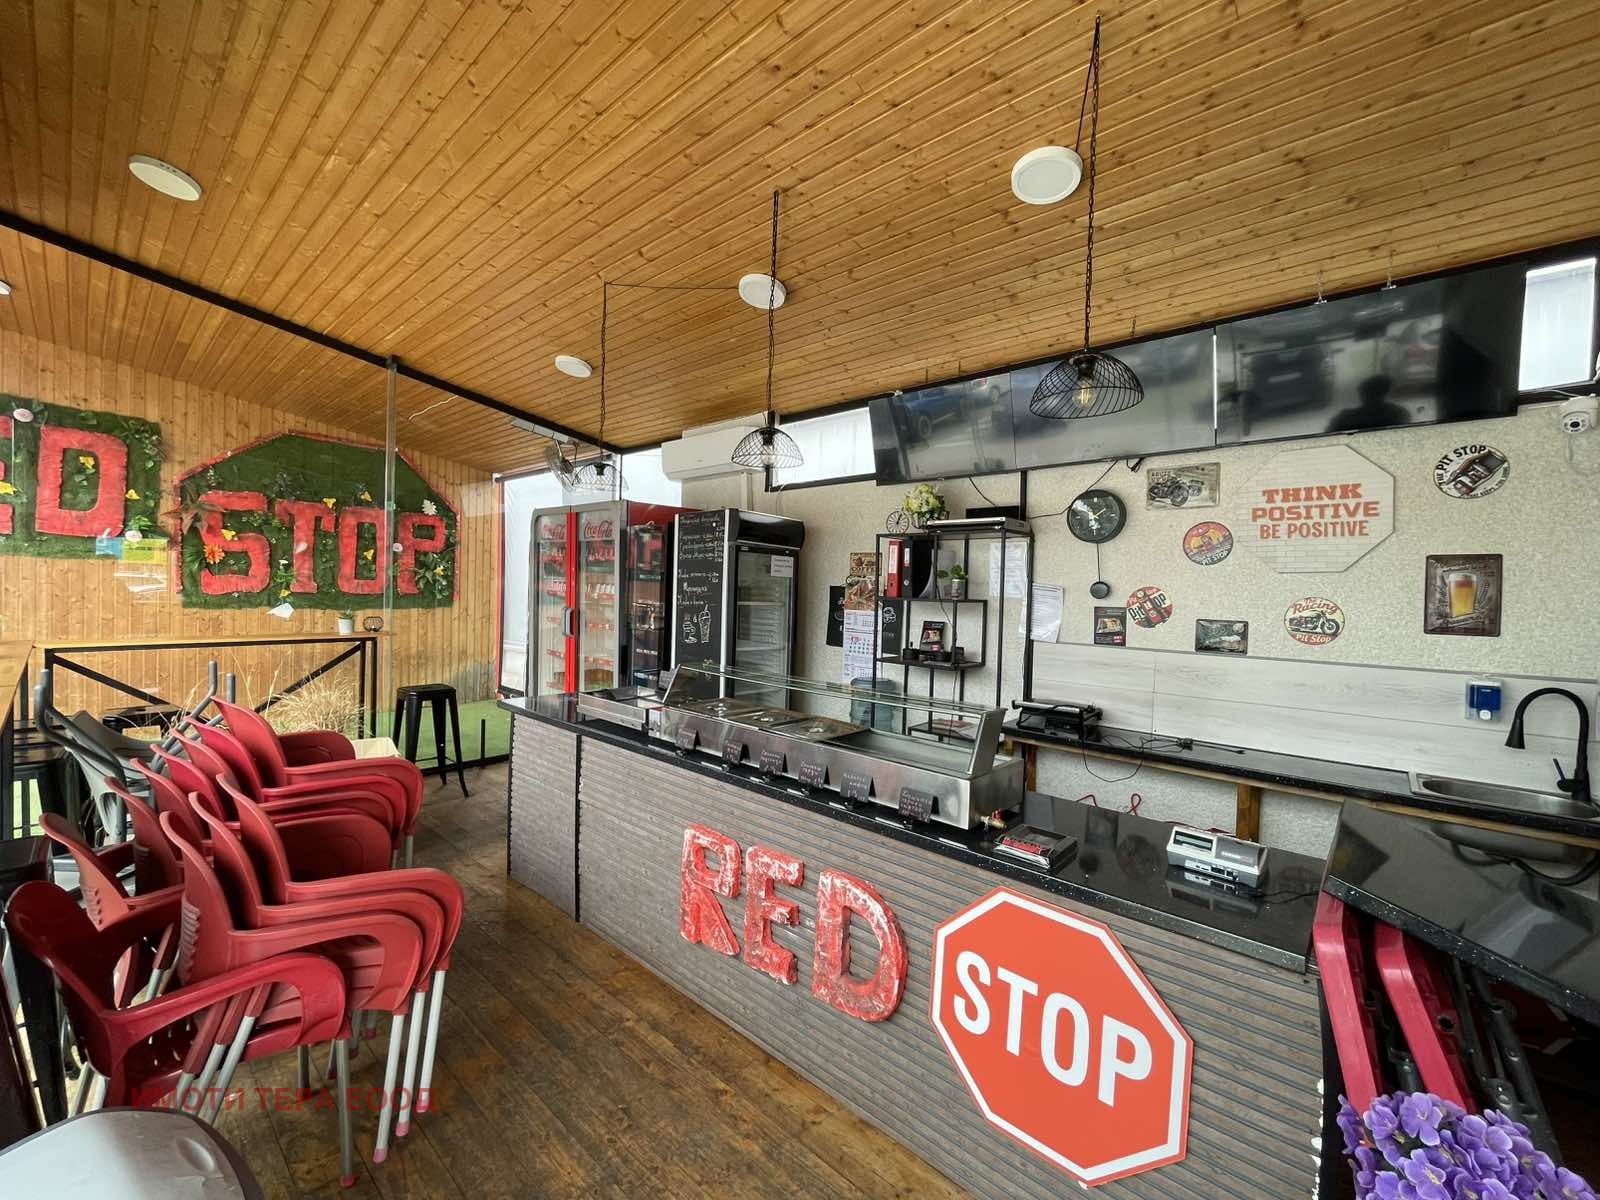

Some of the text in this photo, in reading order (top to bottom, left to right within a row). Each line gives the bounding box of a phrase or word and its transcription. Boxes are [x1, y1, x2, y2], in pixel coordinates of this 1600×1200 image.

[1436, 455, 1453, 471] PIT
[1453, 444, 1487, 457] STOP
[1262, 483, 1362, 504] THINK
[1251, 501, 1380, 522] POSITIVE
[1260, 520, 1369, 539] BE POSITIVE
[199, 490, 446, 595] STOP
[1212, 549, 1229, 561] STOP
[1292, 600, 1339, 616] Racing
[1296, 633, 1332, 644] Pit Stop
[680, 823, 909, 1023] RED
[954, 950, 1153, 1108] STOP
